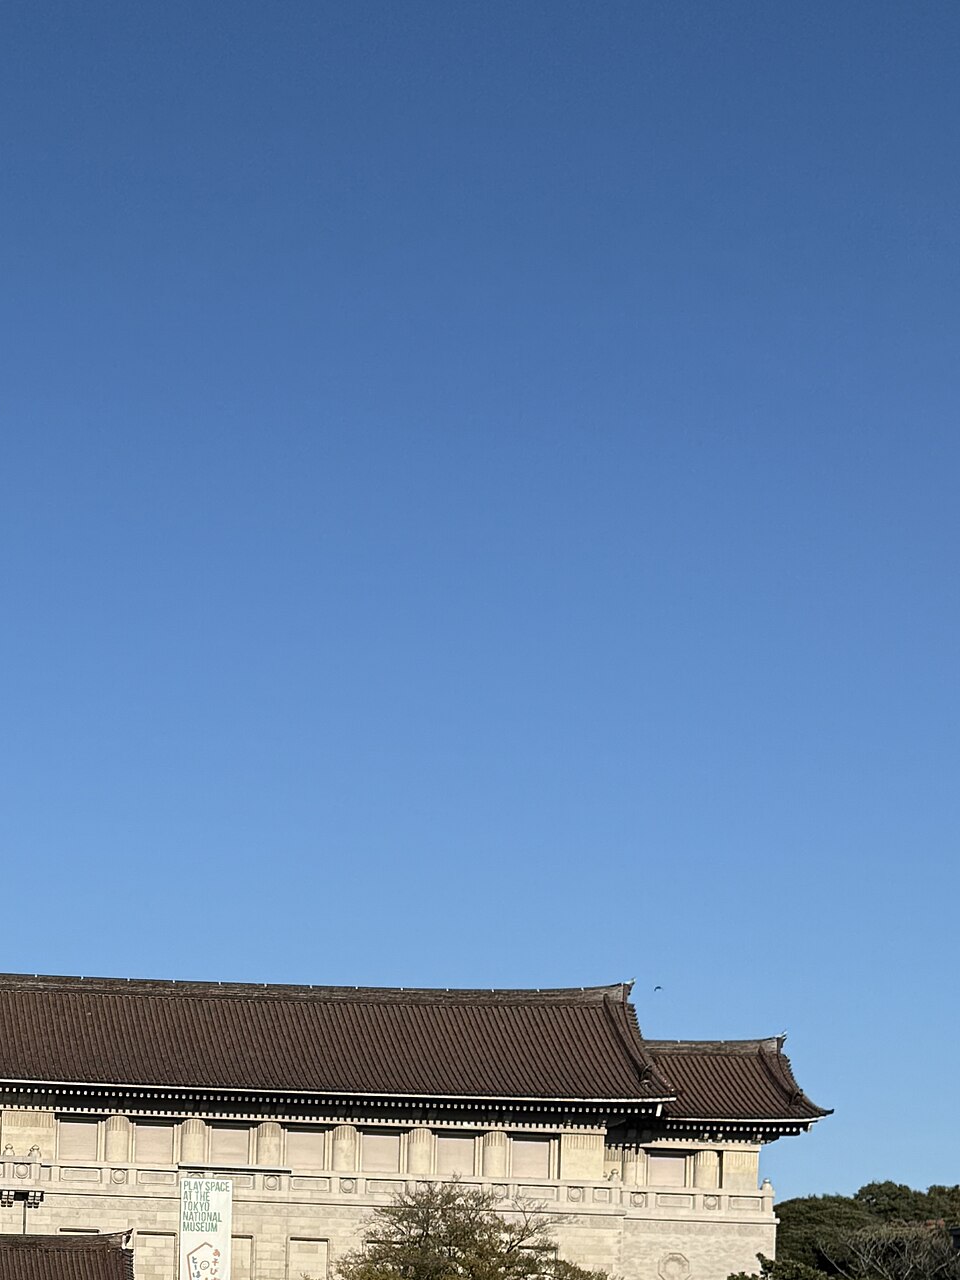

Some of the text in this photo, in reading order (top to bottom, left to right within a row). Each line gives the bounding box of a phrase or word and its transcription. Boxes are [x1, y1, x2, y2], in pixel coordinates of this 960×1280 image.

[183, 1180, 230, 1192] PLAY SPACE
[183, 1190, 210, 1202] AT THE
[183, 1201, 210, 1211] TOKYO
[182, 1211, 222, 1222] NATIONAL
[182, 1221, 218, 1232] MUSEUM
